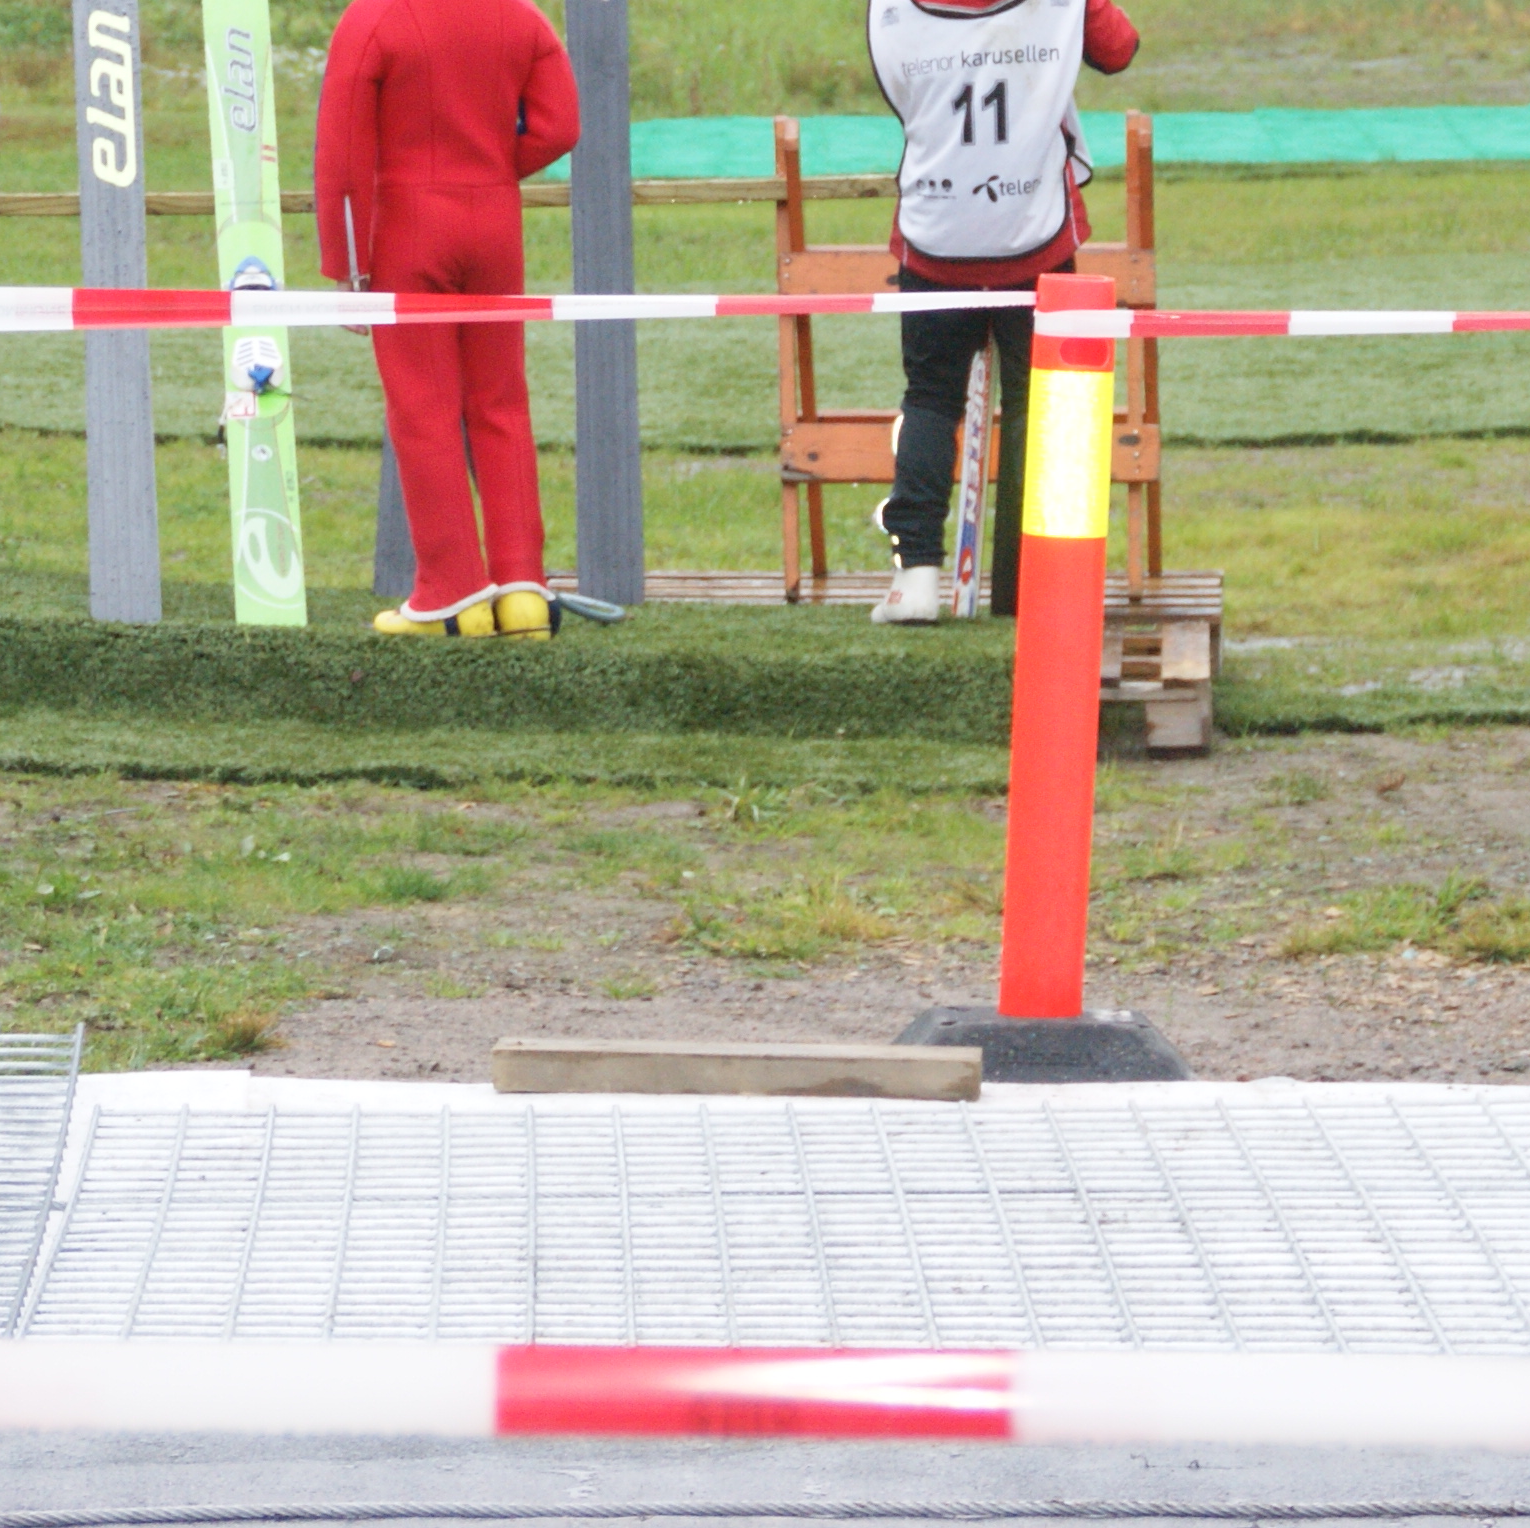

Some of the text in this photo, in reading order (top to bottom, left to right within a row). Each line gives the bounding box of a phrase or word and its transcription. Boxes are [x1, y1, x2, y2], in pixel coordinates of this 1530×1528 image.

[86, 9, 137, 188] elan
[220, 26, 259, 134] elan
[900, 44, 1060, 78] telenor karusellen
[952, 78, 1009, 147] 11
